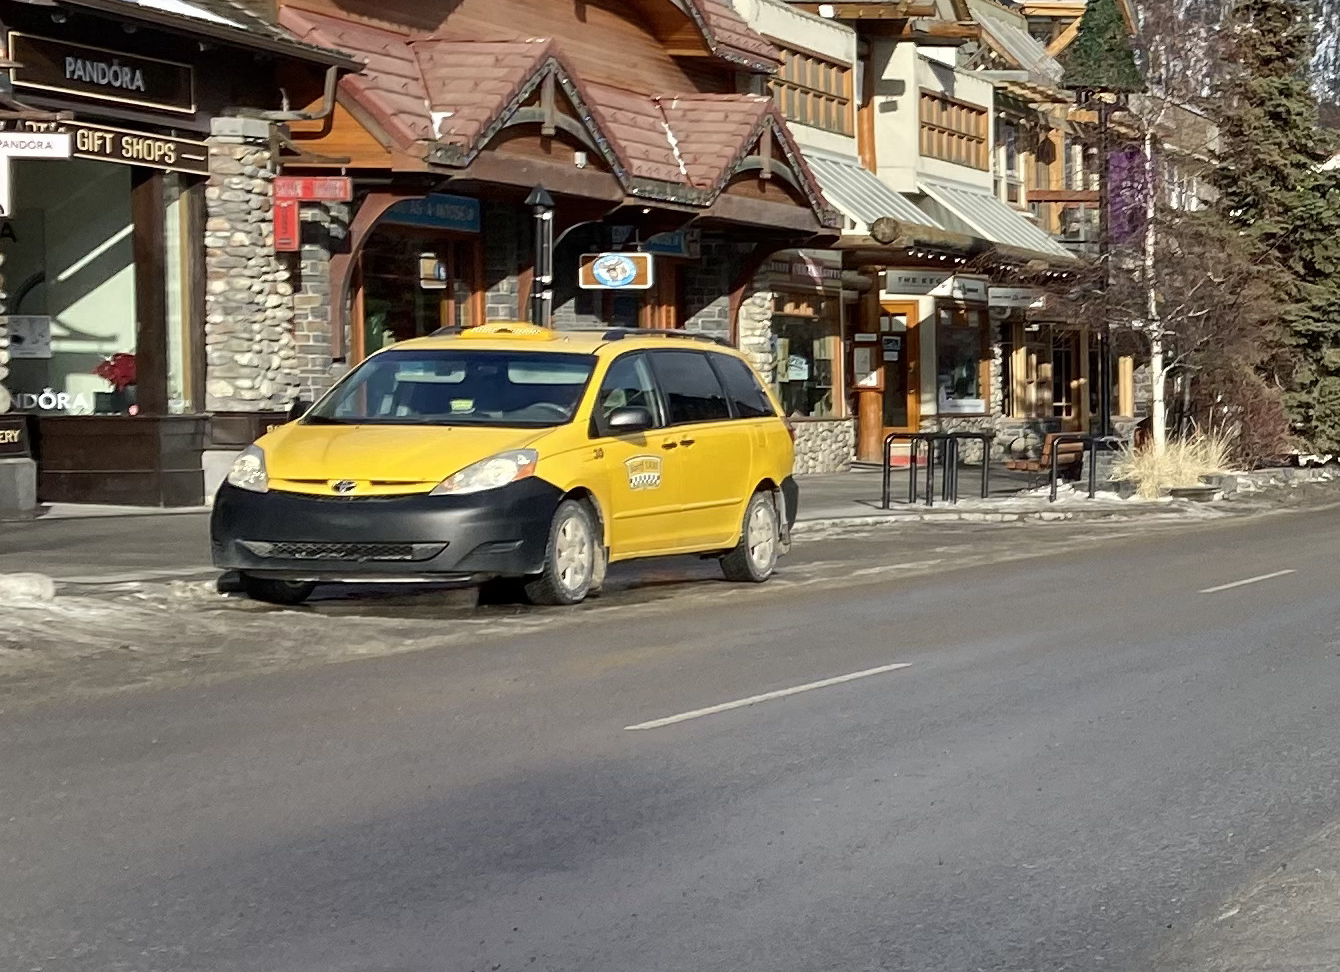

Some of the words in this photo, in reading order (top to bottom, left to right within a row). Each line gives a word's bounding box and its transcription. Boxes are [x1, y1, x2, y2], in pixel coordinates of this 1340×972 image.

[65, 56, 146, 92] PANDORA
[76, 129, 115, 154] GIFT
[121, 136, 177, 164] SHOPS
